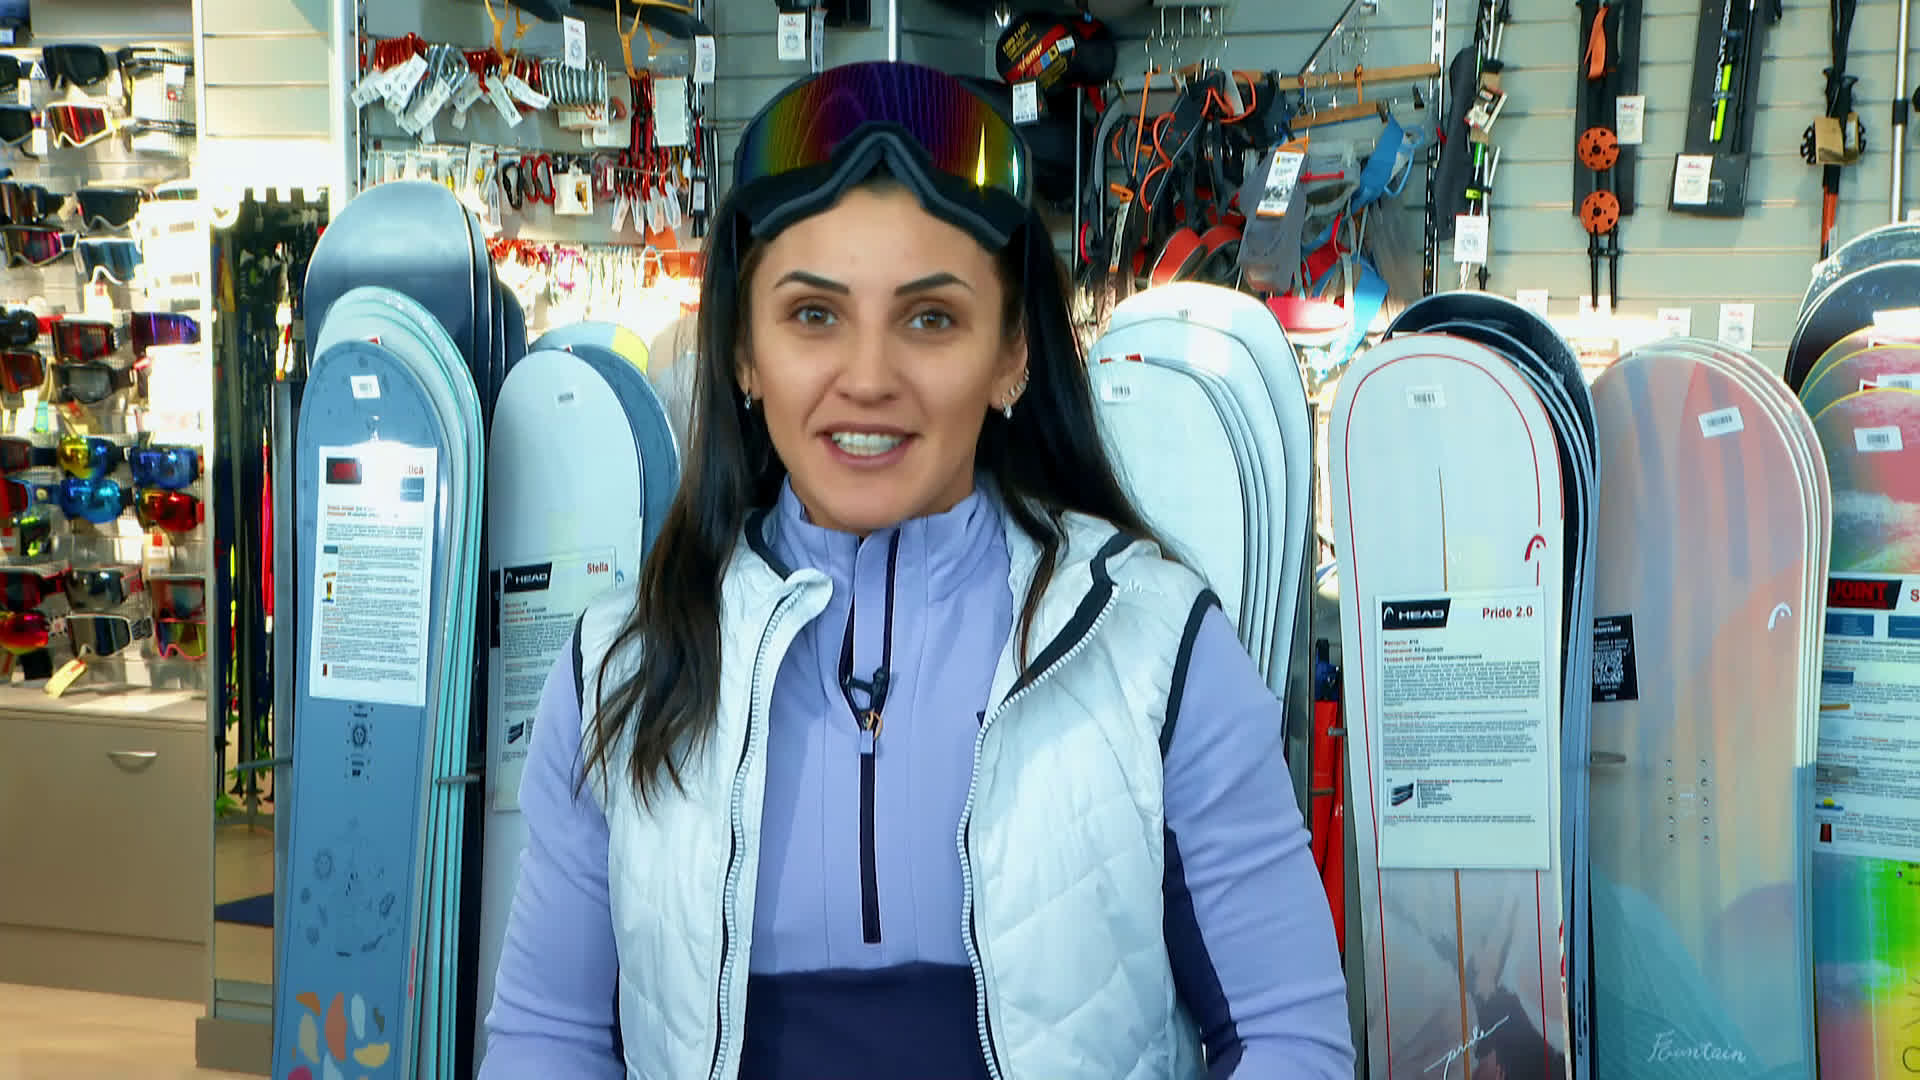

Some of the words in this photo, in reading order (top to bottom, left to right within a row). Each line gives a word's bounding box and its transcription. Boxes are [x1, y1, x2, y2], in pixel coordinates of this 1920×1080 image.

[586, 561, 609, 575] Stella
[515, 572, 548, 585] HEAD
[1398, 609, 1445, 621] HEAD
[1482, 607, 1513, 620] Pride
[1516, 605, 1534, 618] 2.0
